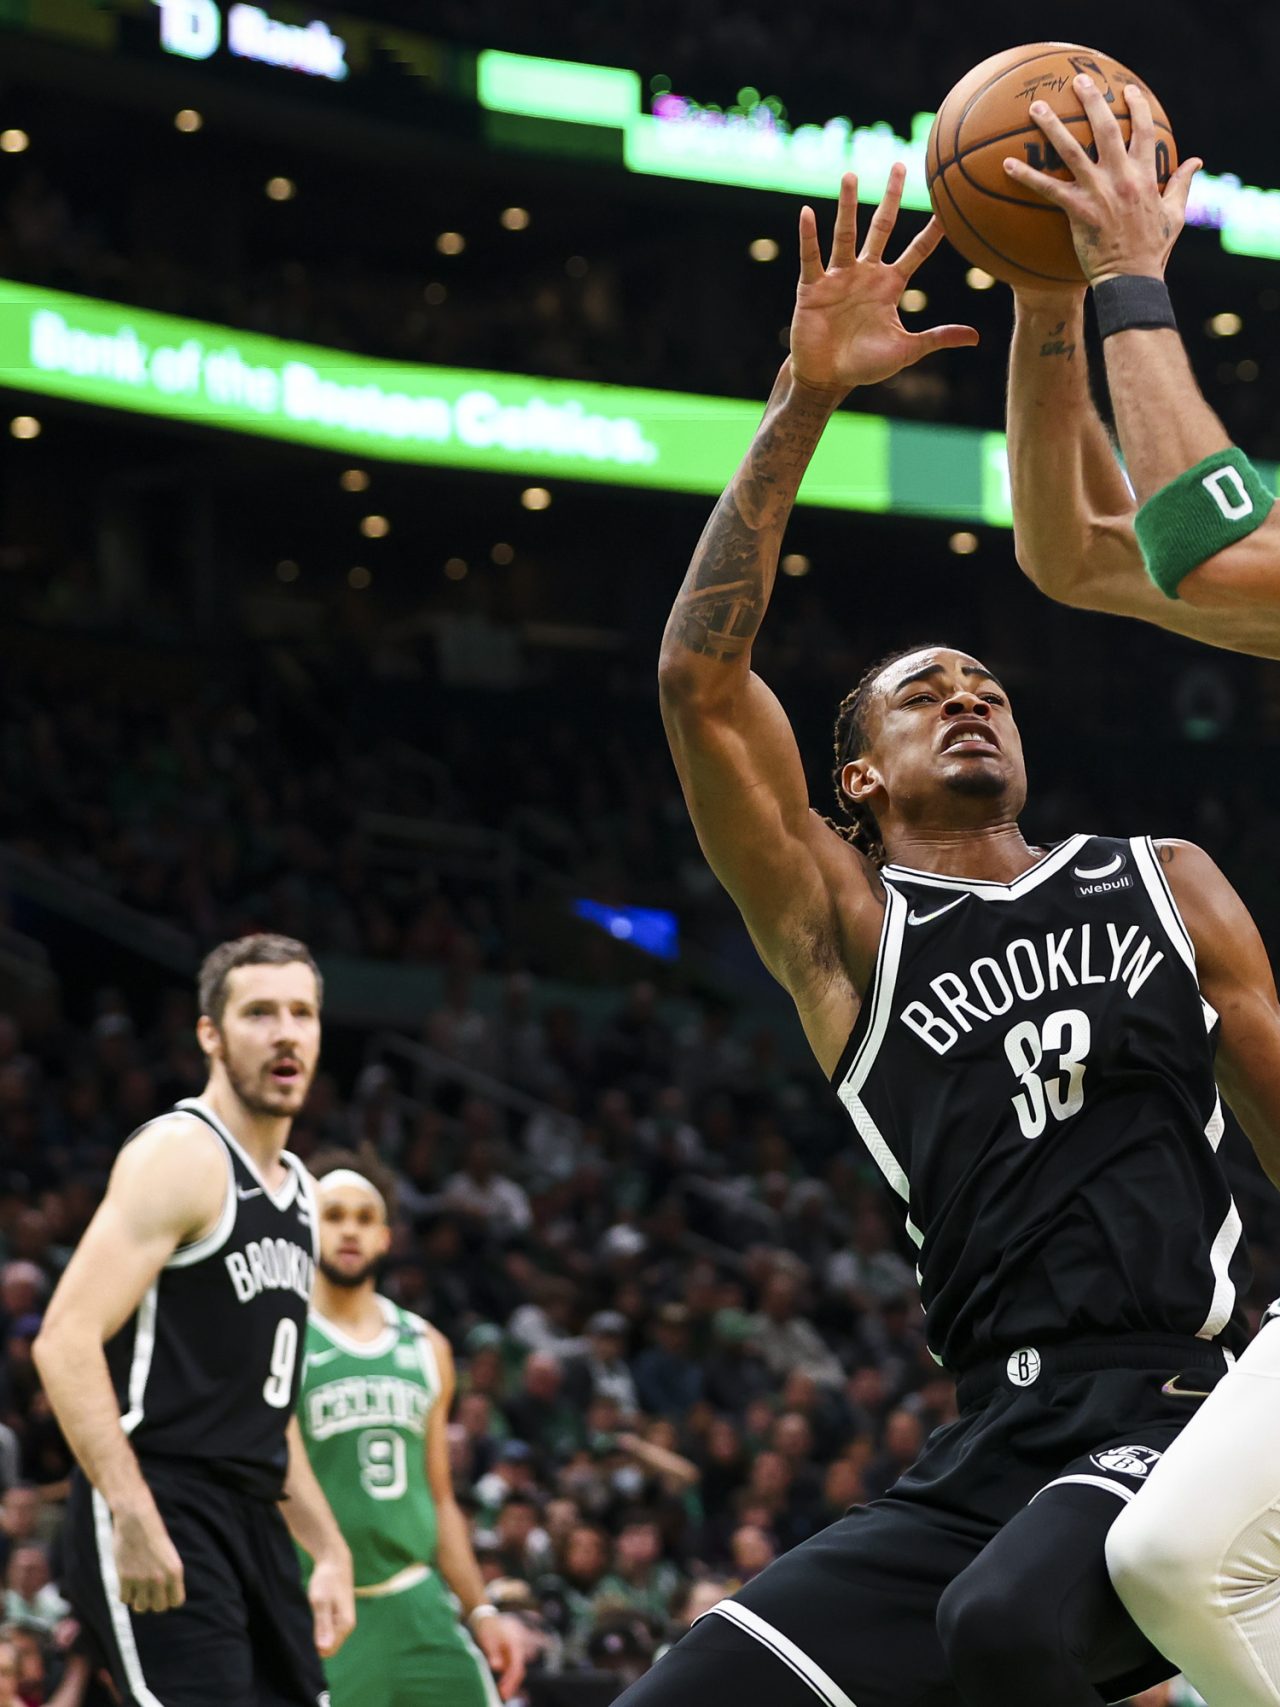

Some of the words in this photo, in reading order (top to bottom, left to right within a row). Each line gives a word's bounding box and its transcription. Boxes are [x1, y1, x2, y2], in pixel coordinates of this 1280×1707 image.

[1079, 876, 1130, 896] Webull
[900, 922, 1164, 1056] BROOKLYN
[1003, 1008, 1091, 1140] 33
[263, 1317, 298, 1409] 9
[357, 1428, 408, 1501] 9
